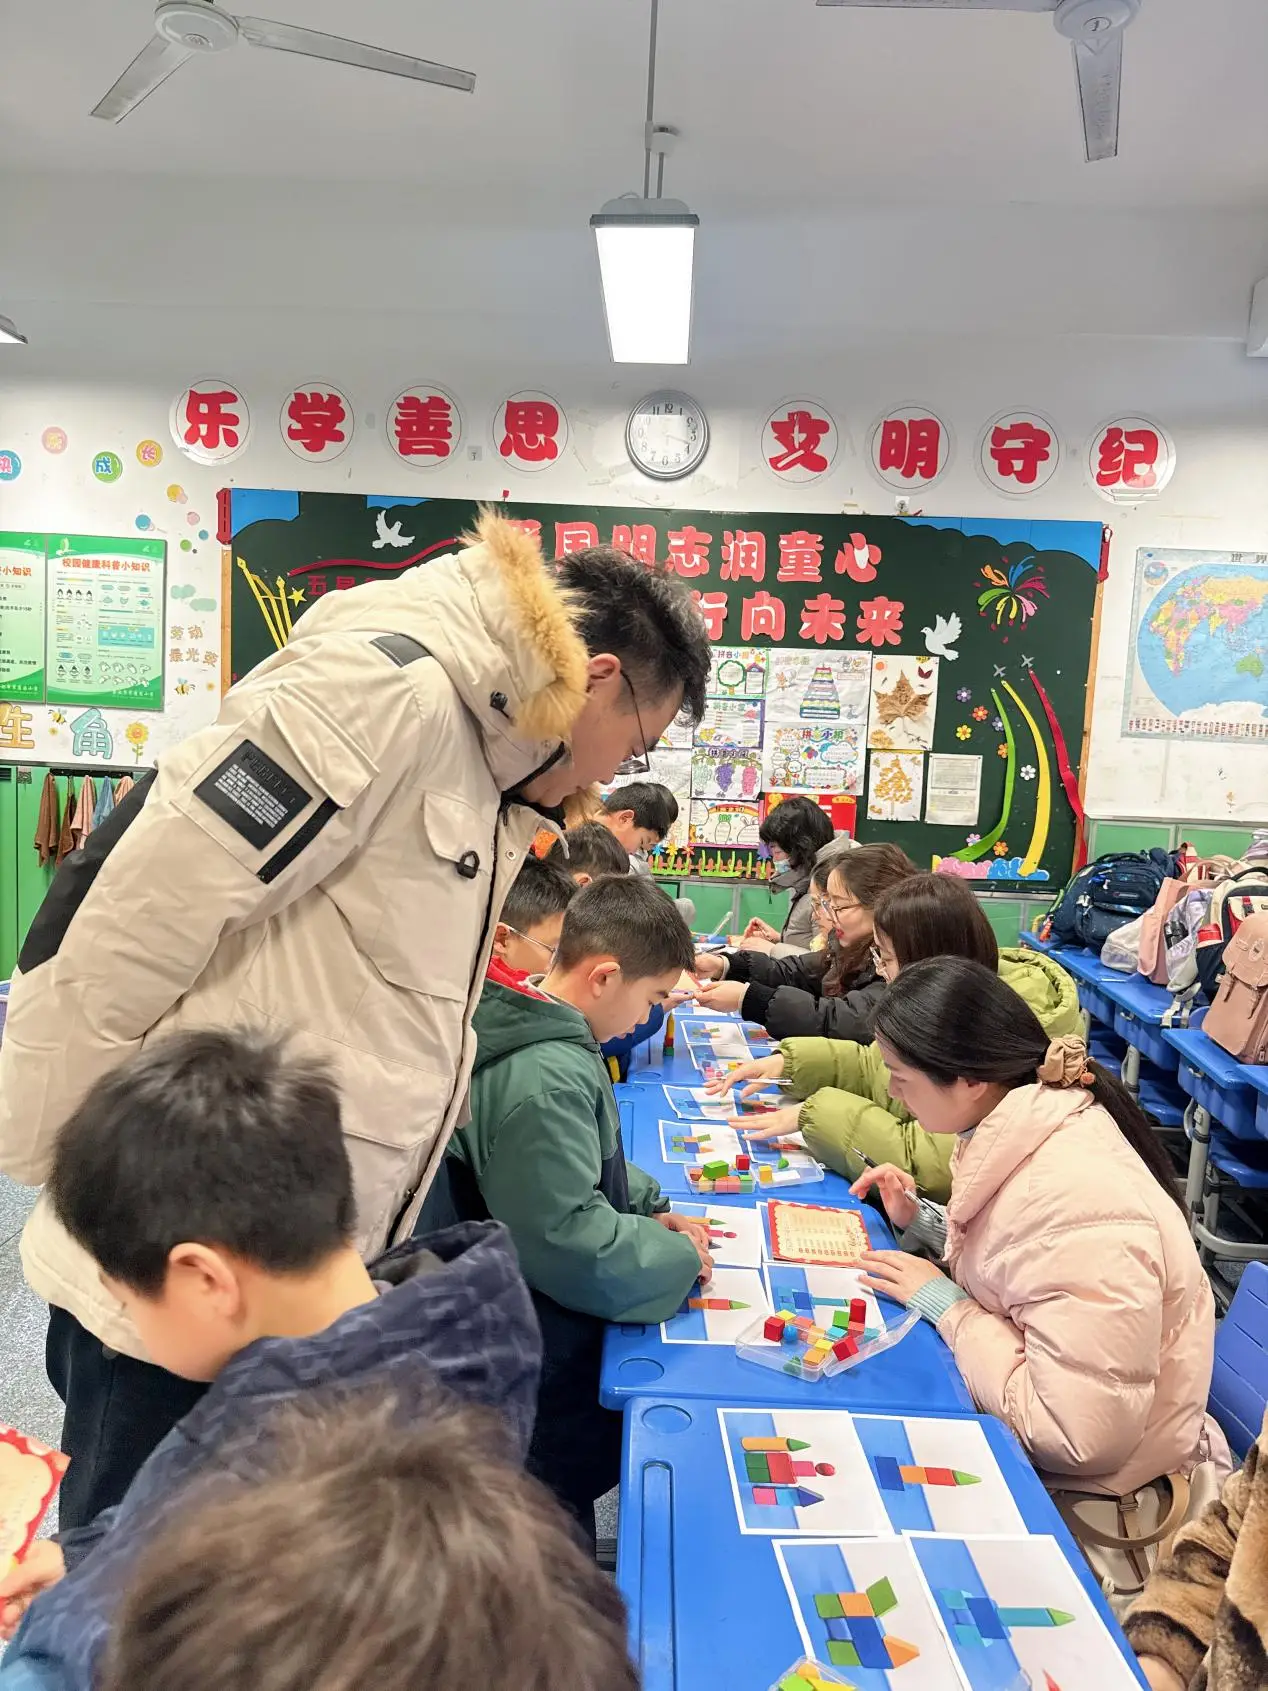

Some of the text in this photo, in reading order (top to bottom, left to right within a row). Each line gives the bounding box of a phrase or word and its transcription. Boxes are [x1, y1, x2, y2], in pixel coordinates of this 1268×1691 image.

[184, 389, 560, 462] 乐学善思
[769, 410, 1159, 487] 文明守纪
[0, 565, 32, 577] 小知识
[62, 557, 151, 573] 校园健康科普小知识
